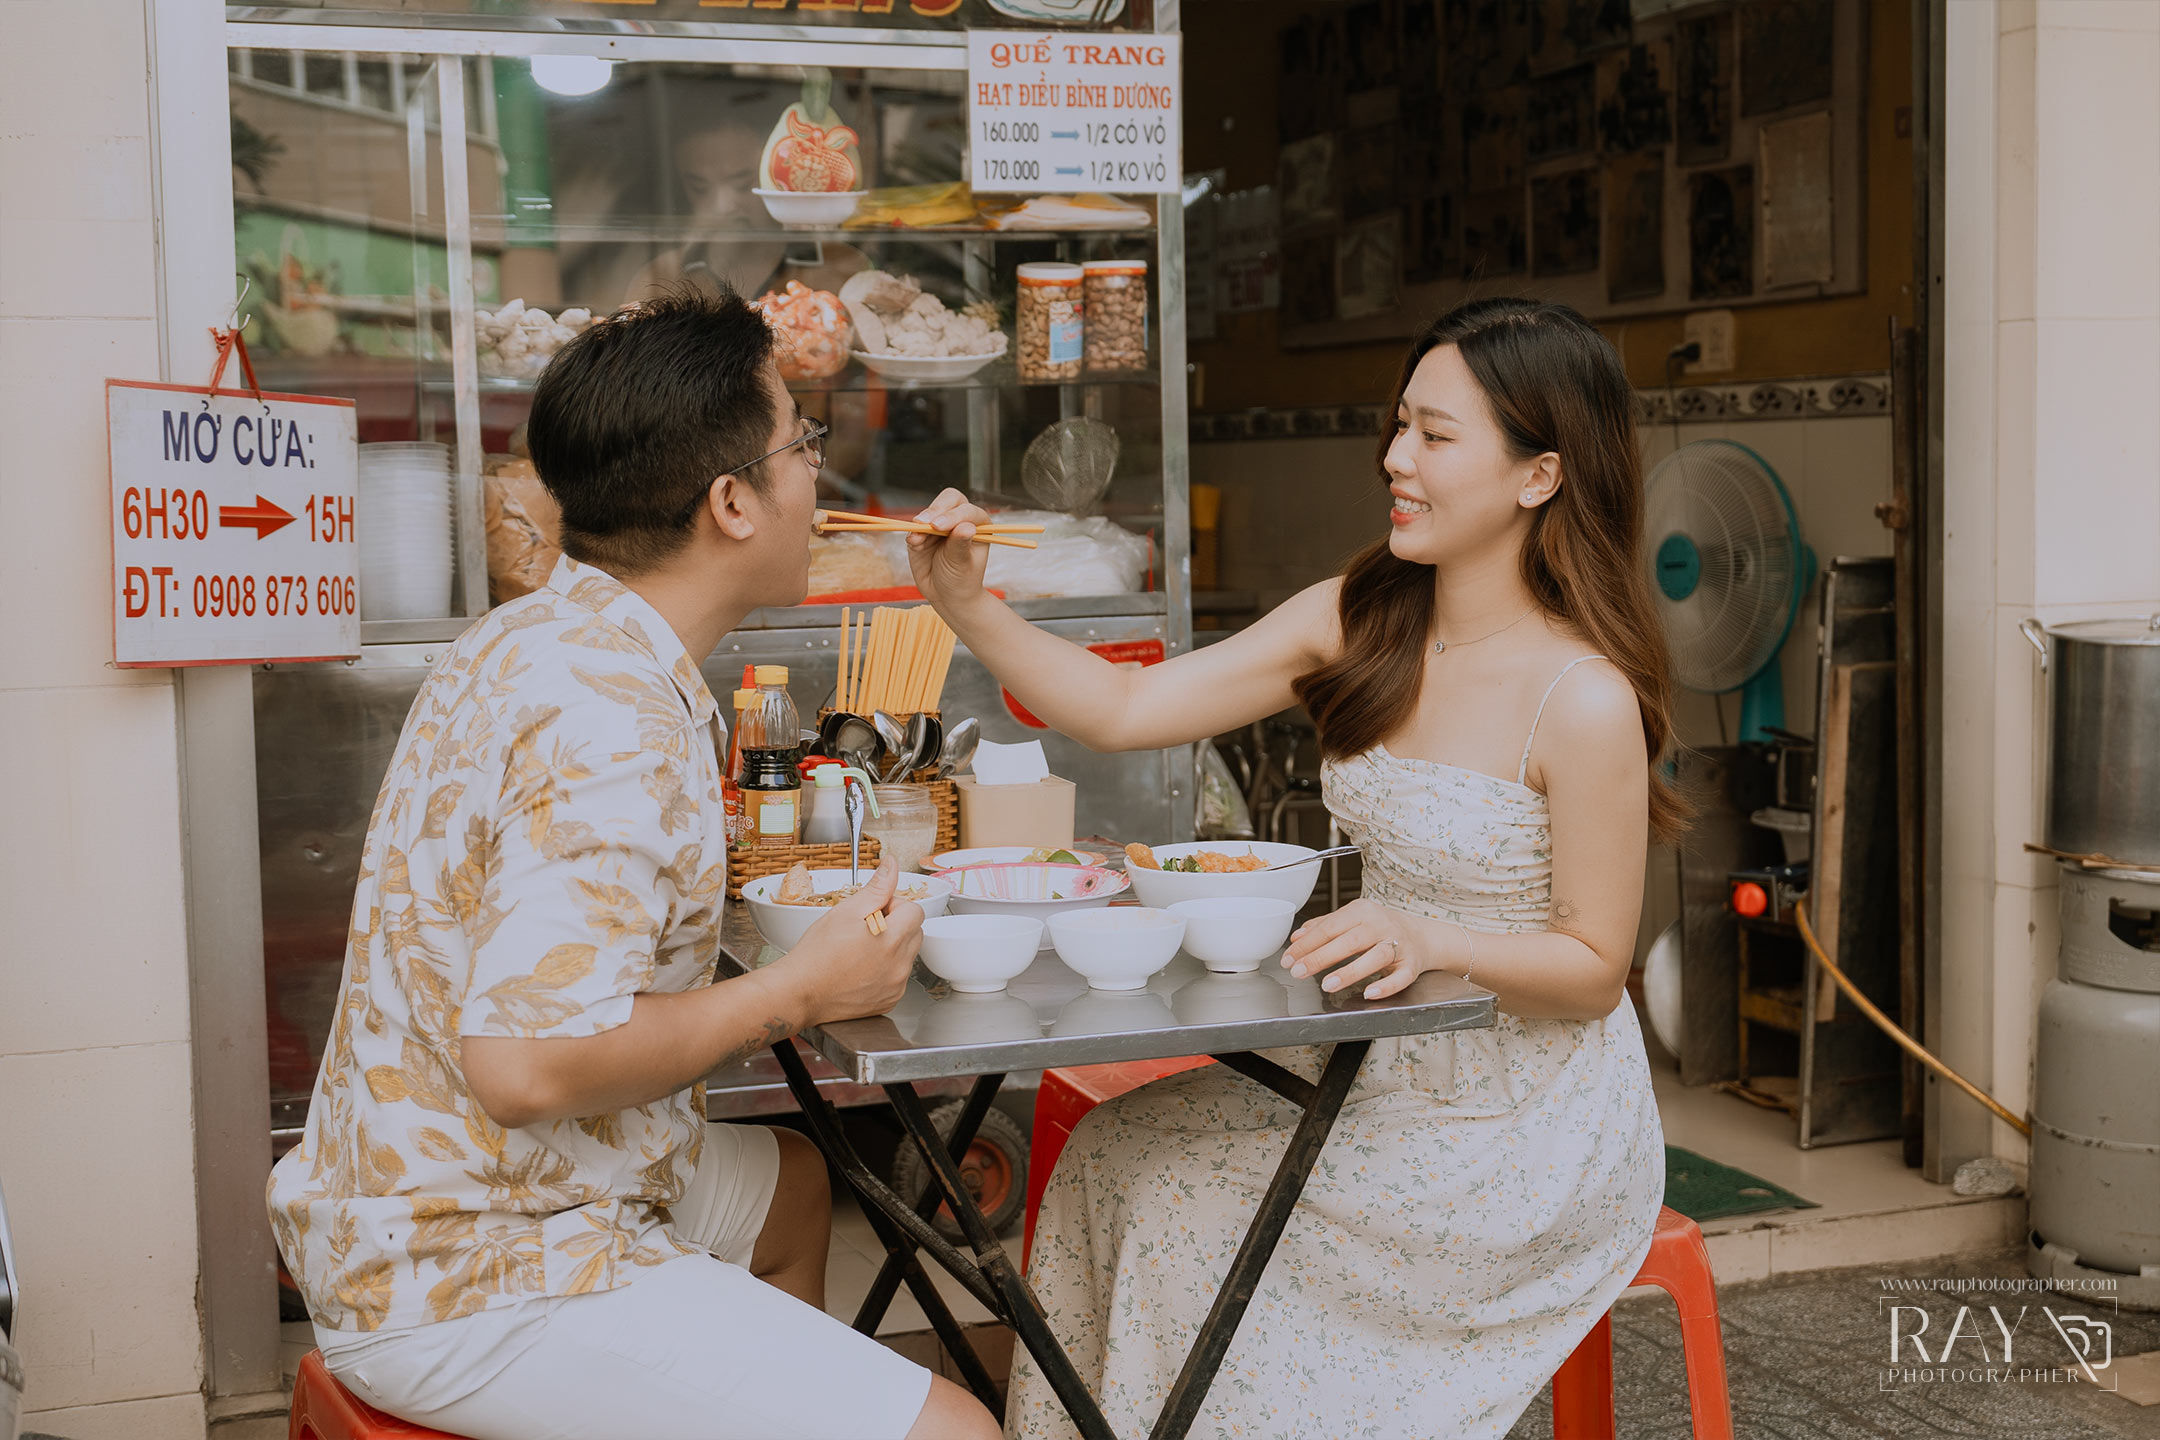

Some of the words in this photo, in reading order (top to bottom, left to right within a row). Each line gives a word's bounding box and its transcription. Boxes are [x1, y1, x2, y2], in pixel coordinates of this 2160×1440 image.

[990, 35, 1052, 68] QUẾ
[1063, 45, 1166, 66] TRANG
[977, 83, 1013, 111] HẠT
[1066, 78, 1107, 108] BÌNH
[1113, 82, 1172, 109] DƯƠNG
[983, 121, 1039, 143] 160.000
[1087, 123, 1110, 147] 1/2
[1114, 118, 1138, 144] CÓ
[1143, 116, 1166, 145] VỎ
[984, 159, 1040, 181] 170.000
[1091, 161, 1114, 185] 1/2
[1119, 161, 1139, 181] KO
[1143, 154, 1166, 182] VỎ
[163, 400, 222, 464] MỞ
[233, 405, 315, 468] CỬA:
[123, 486, 209, 541] 6H30
[305, 494, 355, 543] 15H
[123, 566, 179, 618] ĐT:
[193, 575, 256, 618] 0908
[266, 575, 308, 617] 873
[317, 575, 356, 616] 606
